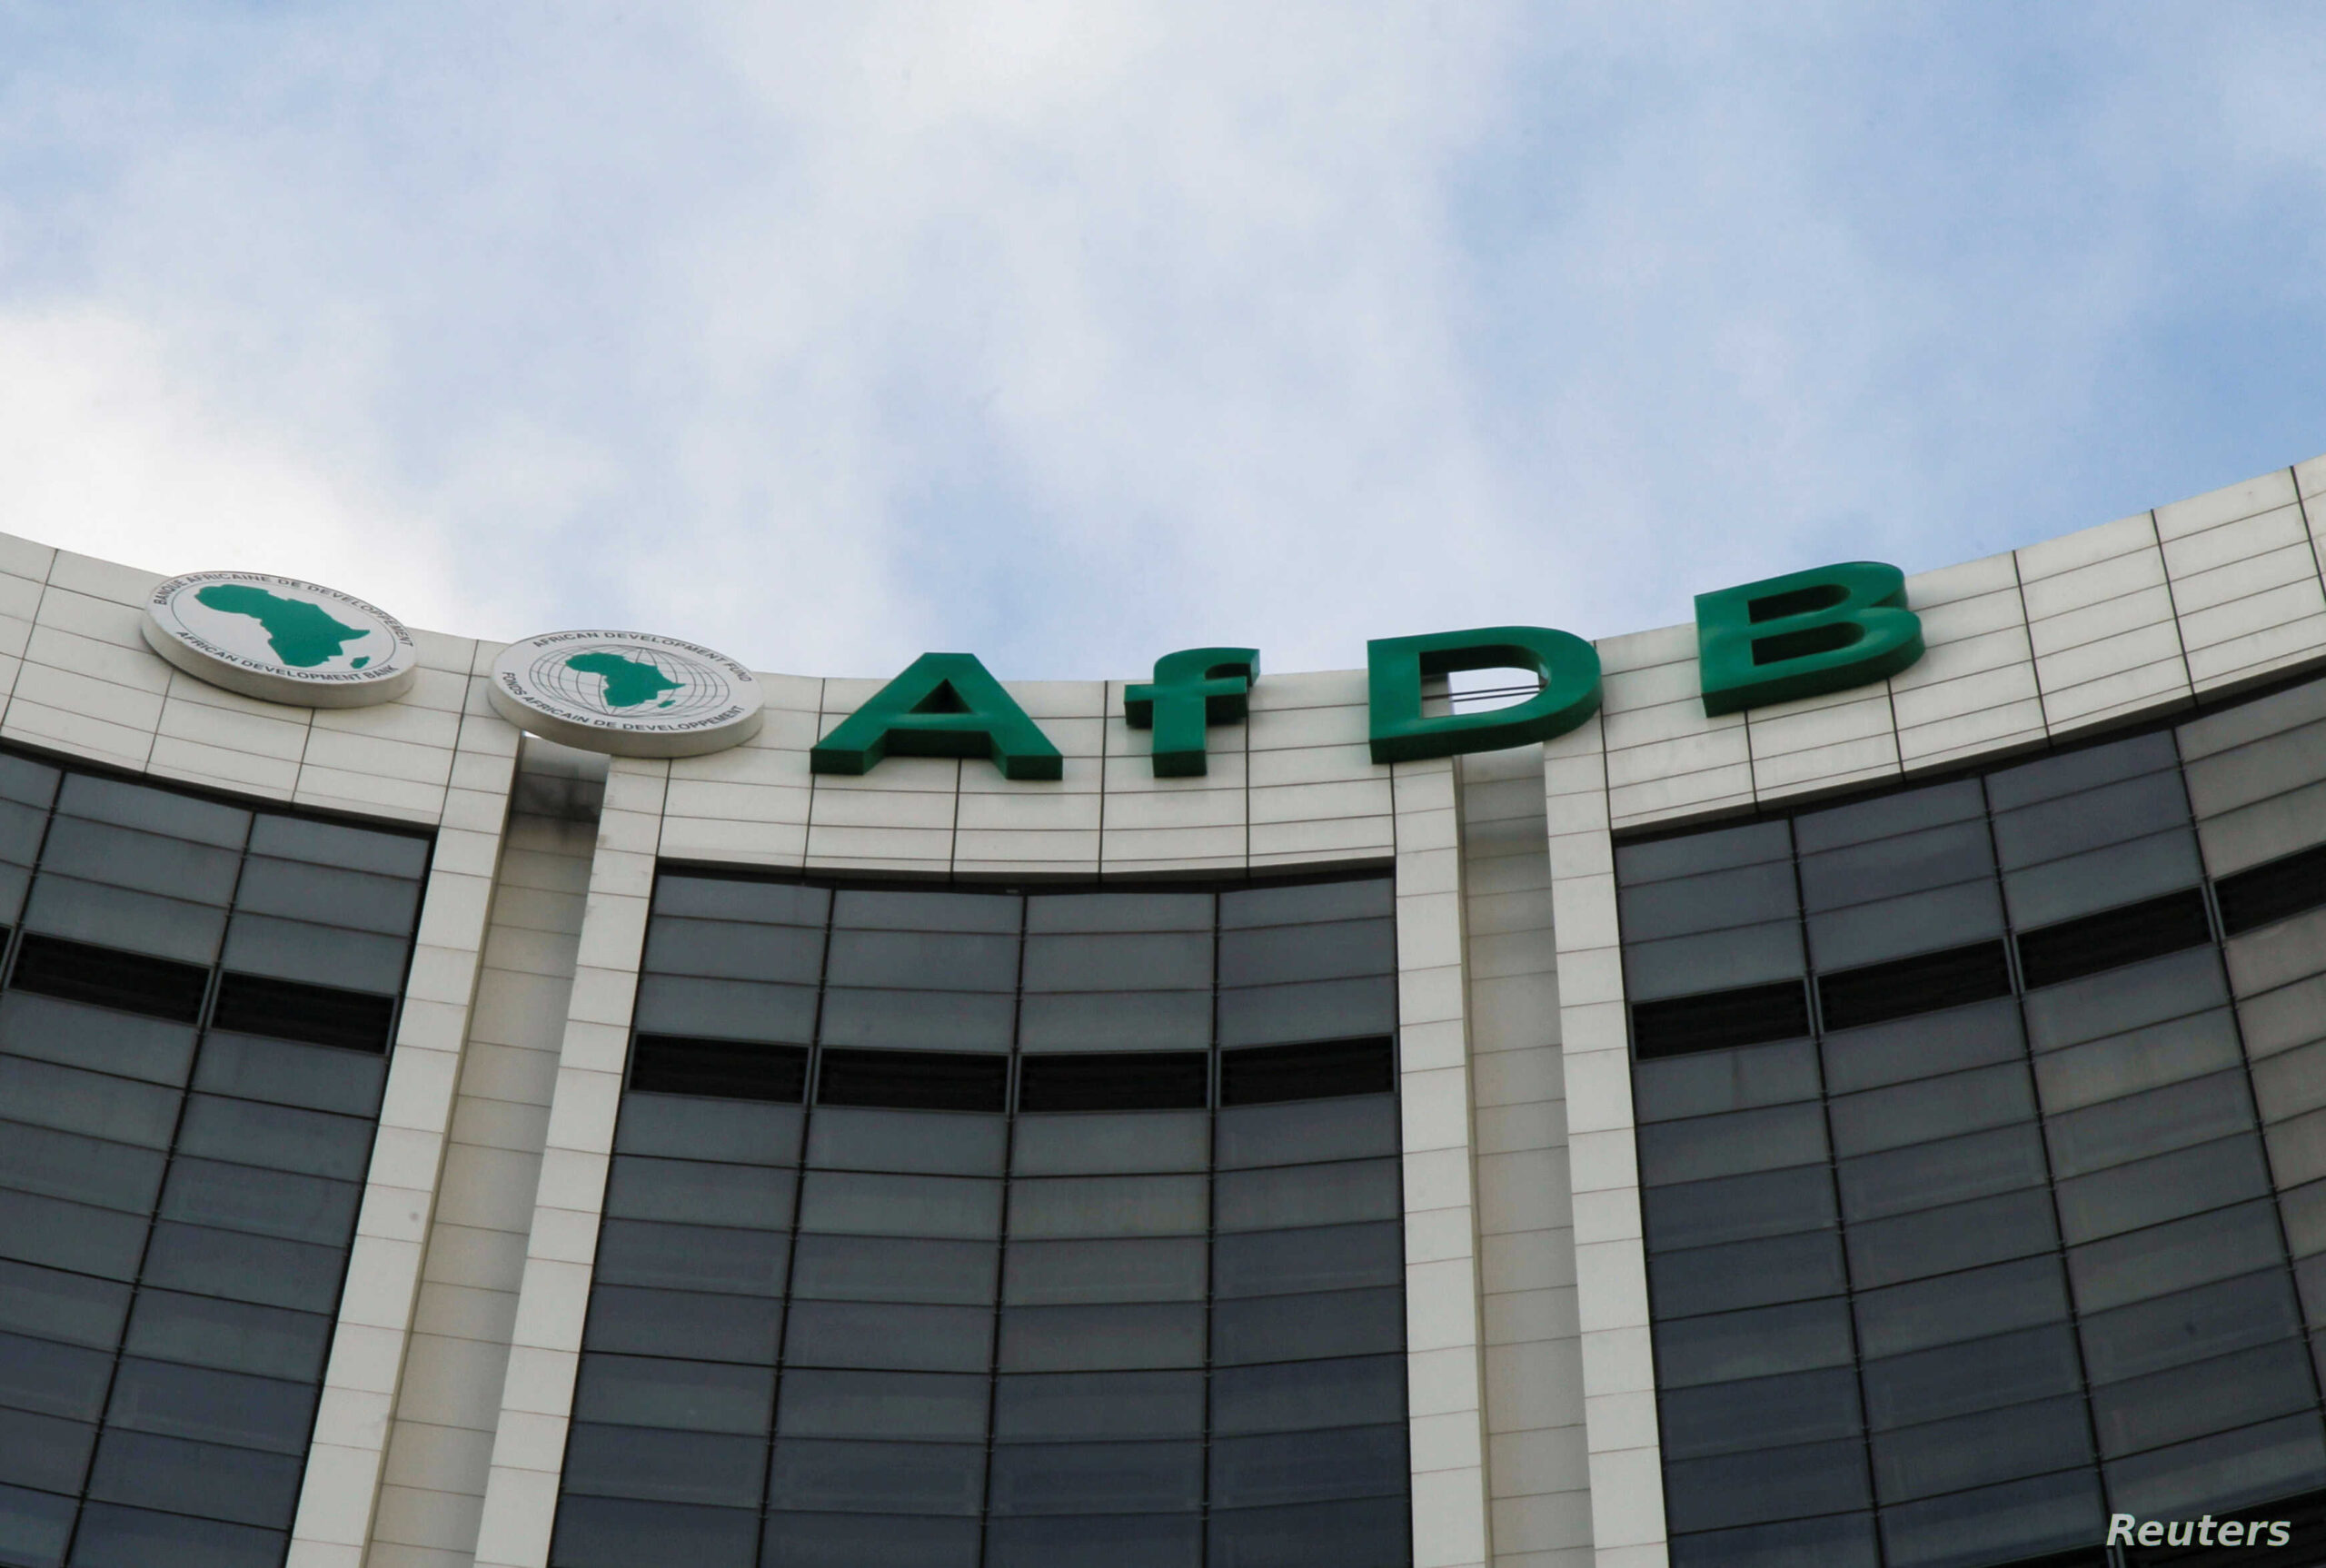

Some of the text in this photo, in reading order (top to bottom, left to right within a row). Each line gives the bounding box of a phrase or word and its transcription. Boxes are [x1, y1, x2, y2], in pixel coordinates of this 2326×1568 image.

[153, 580, 187, 606] BANQUE
[186, 573, 271, 583] AFRICAINE
[278, 579, 301, 588] DE
[176, 630, 399, 681] AFRICAN DEVELOPMENT BANK
[532, 632, 752, 682] AFRICAN DEVELOPMENT FUND
[810, 561, 1926, 779] AfDB
[502, 671, 745, 731] FONDS AFRICAIN DE DEVELOPPEMENT
